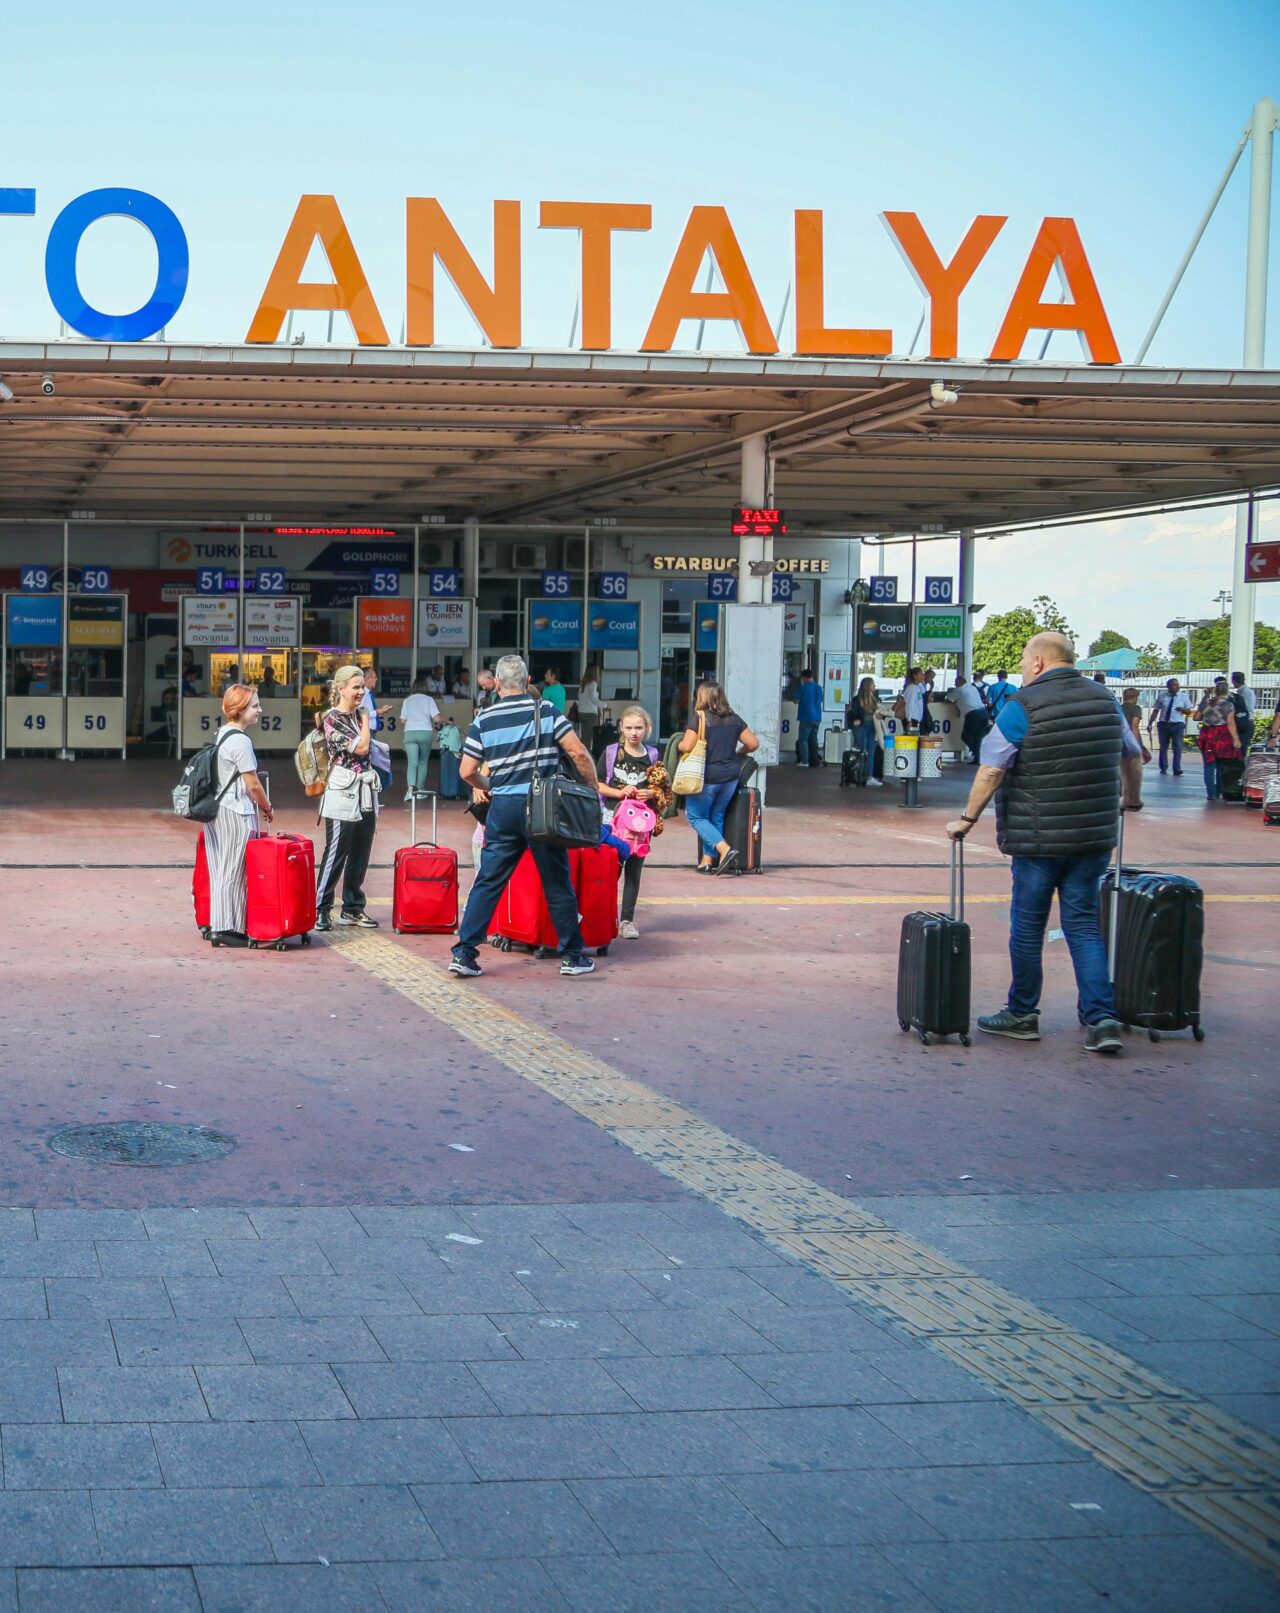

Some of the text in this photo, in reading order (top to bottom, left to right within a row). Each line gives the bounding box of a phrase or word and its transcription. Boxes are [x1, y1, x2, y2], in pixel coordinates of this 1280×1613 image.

[245, 194, 1121, 365] ANTALYA
[742, 509, 779, 522] TAXI
[194, 544, 278, 558] TURKCELL
[342, 552, 408, 562] GOLDPHONE
[775, 559, 830, 572] OFFEE
[23, 570, 48, 588] 49
[84, 571, 108, 588] 50
[201, 572, 222, 590] 51
[260, 572, 283, 590] 52
[374, 574, 398, 591] 53
[433, 574, 456, 592] 54
[545, 576, 568, 593] 55
[603, 577, 626, 594] 56
[712, 578, 734, 596] 57
[874, 581, 896, 598] 59
[929, 582, 951, 598] 60
[366, 614, 406, 624] easyJet
[366, 622, 406, 632] holidays
[551, 620, 579, 629] Coral
[608, 620, 636, 630] Coral
[921, 618, 958, 628] ODEON
[880, 624, 906, 632] Coral
[24, 714, 46, 730] 49
[84, 714, 106, 730] 50
[201, 716, 222, 730] 51
[261, 716, 282, 731] 52
[933, 720, 952, 734] 60
